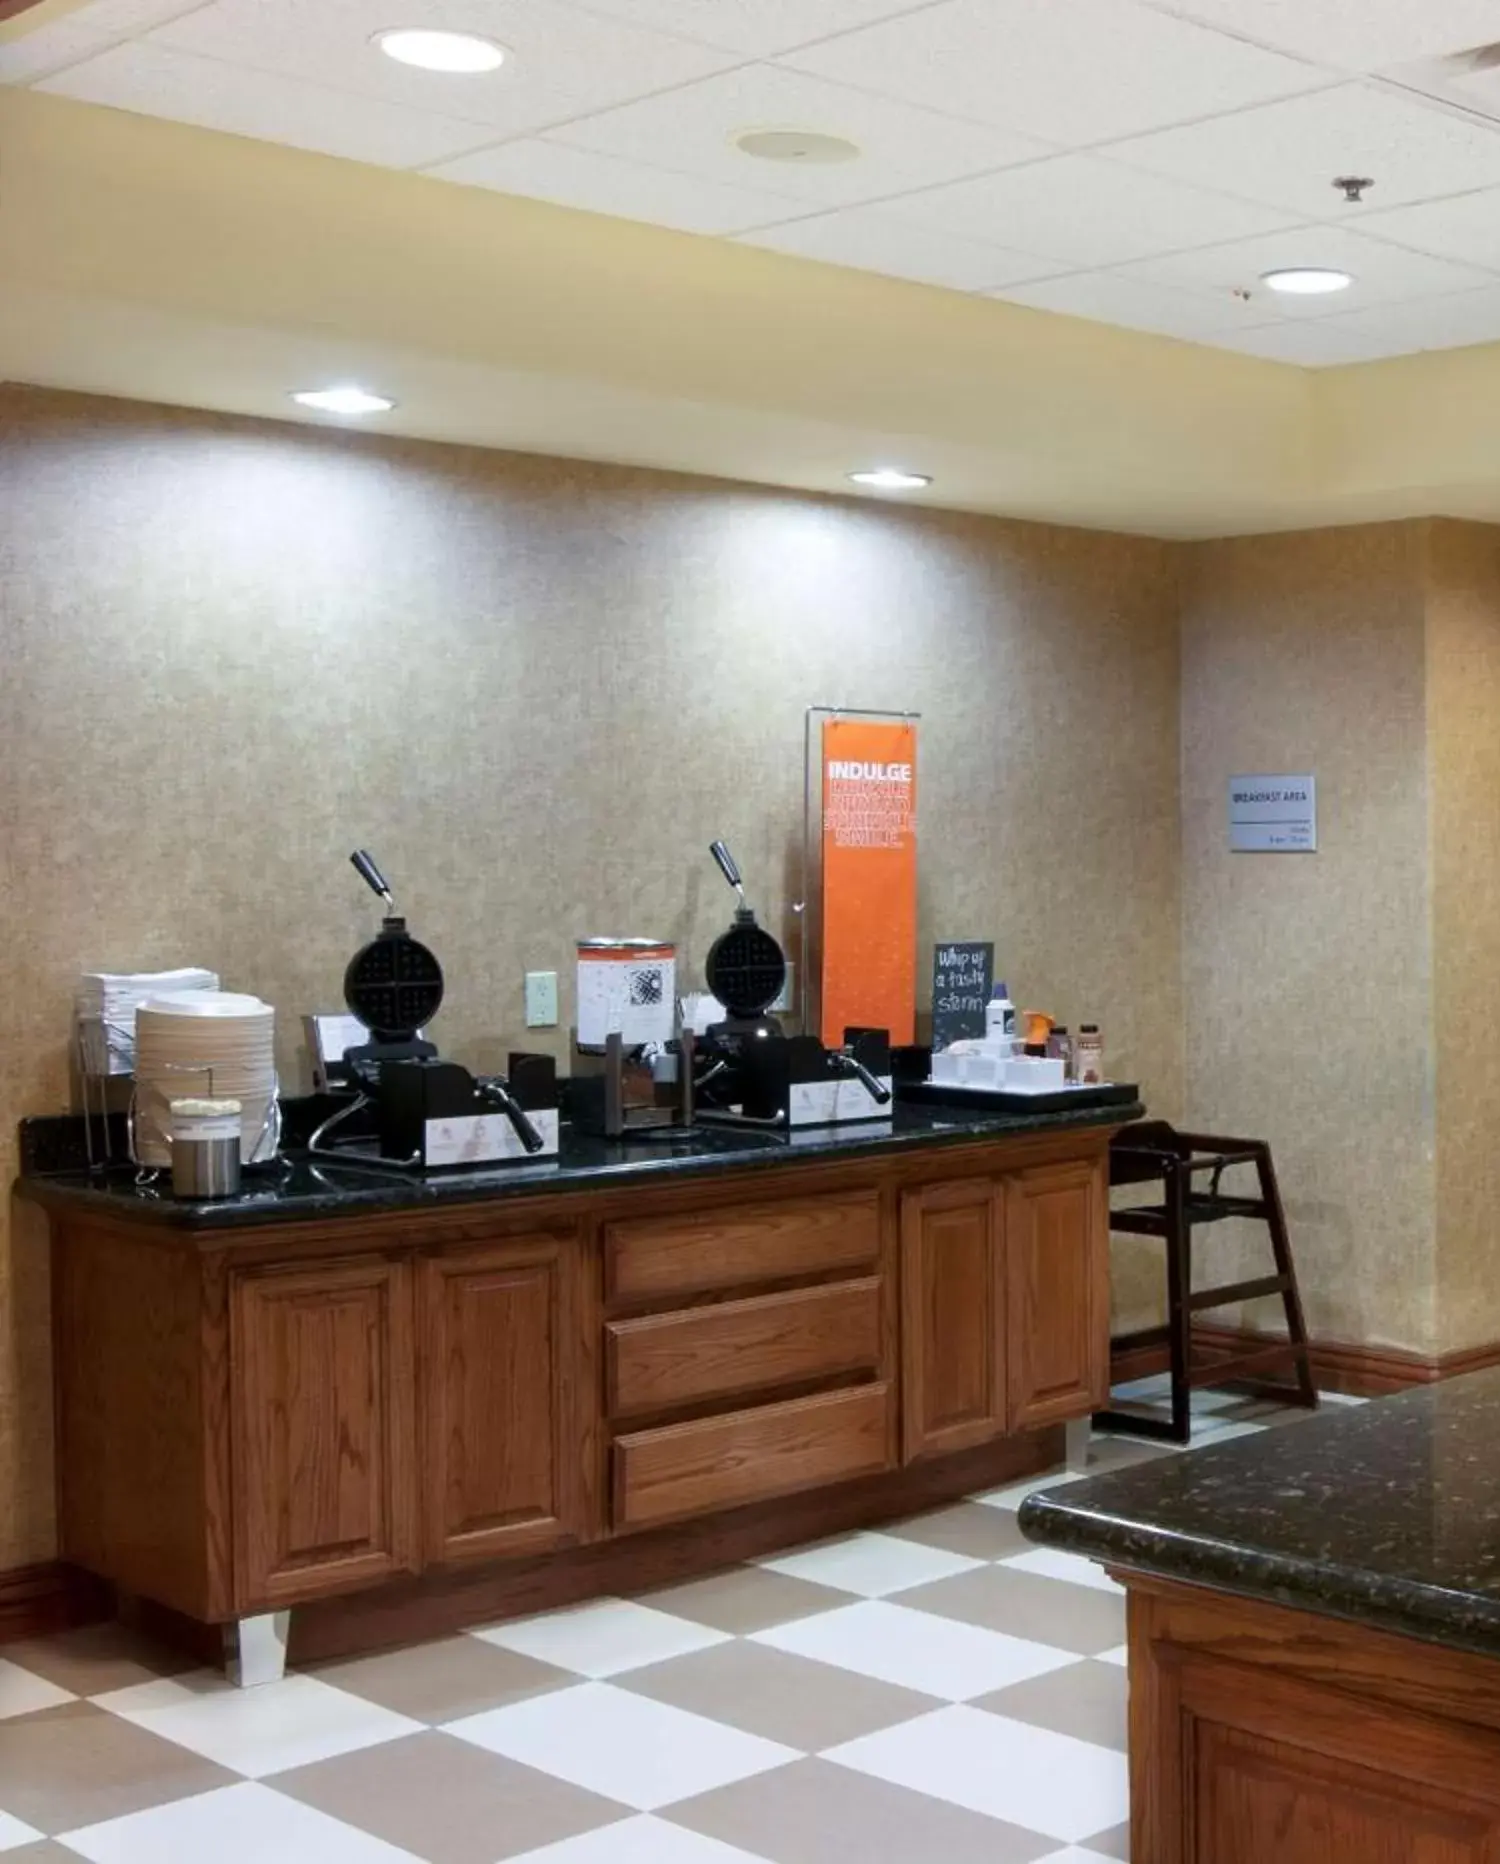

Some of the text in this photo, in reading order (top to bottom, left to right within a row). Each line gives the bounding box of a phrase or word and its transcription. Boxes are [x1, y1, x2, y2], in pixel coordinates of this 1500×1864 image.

[828, 761, 912, 781] INDULGE
[1232, 791, 1307, 803] BREAKFAST AREA
